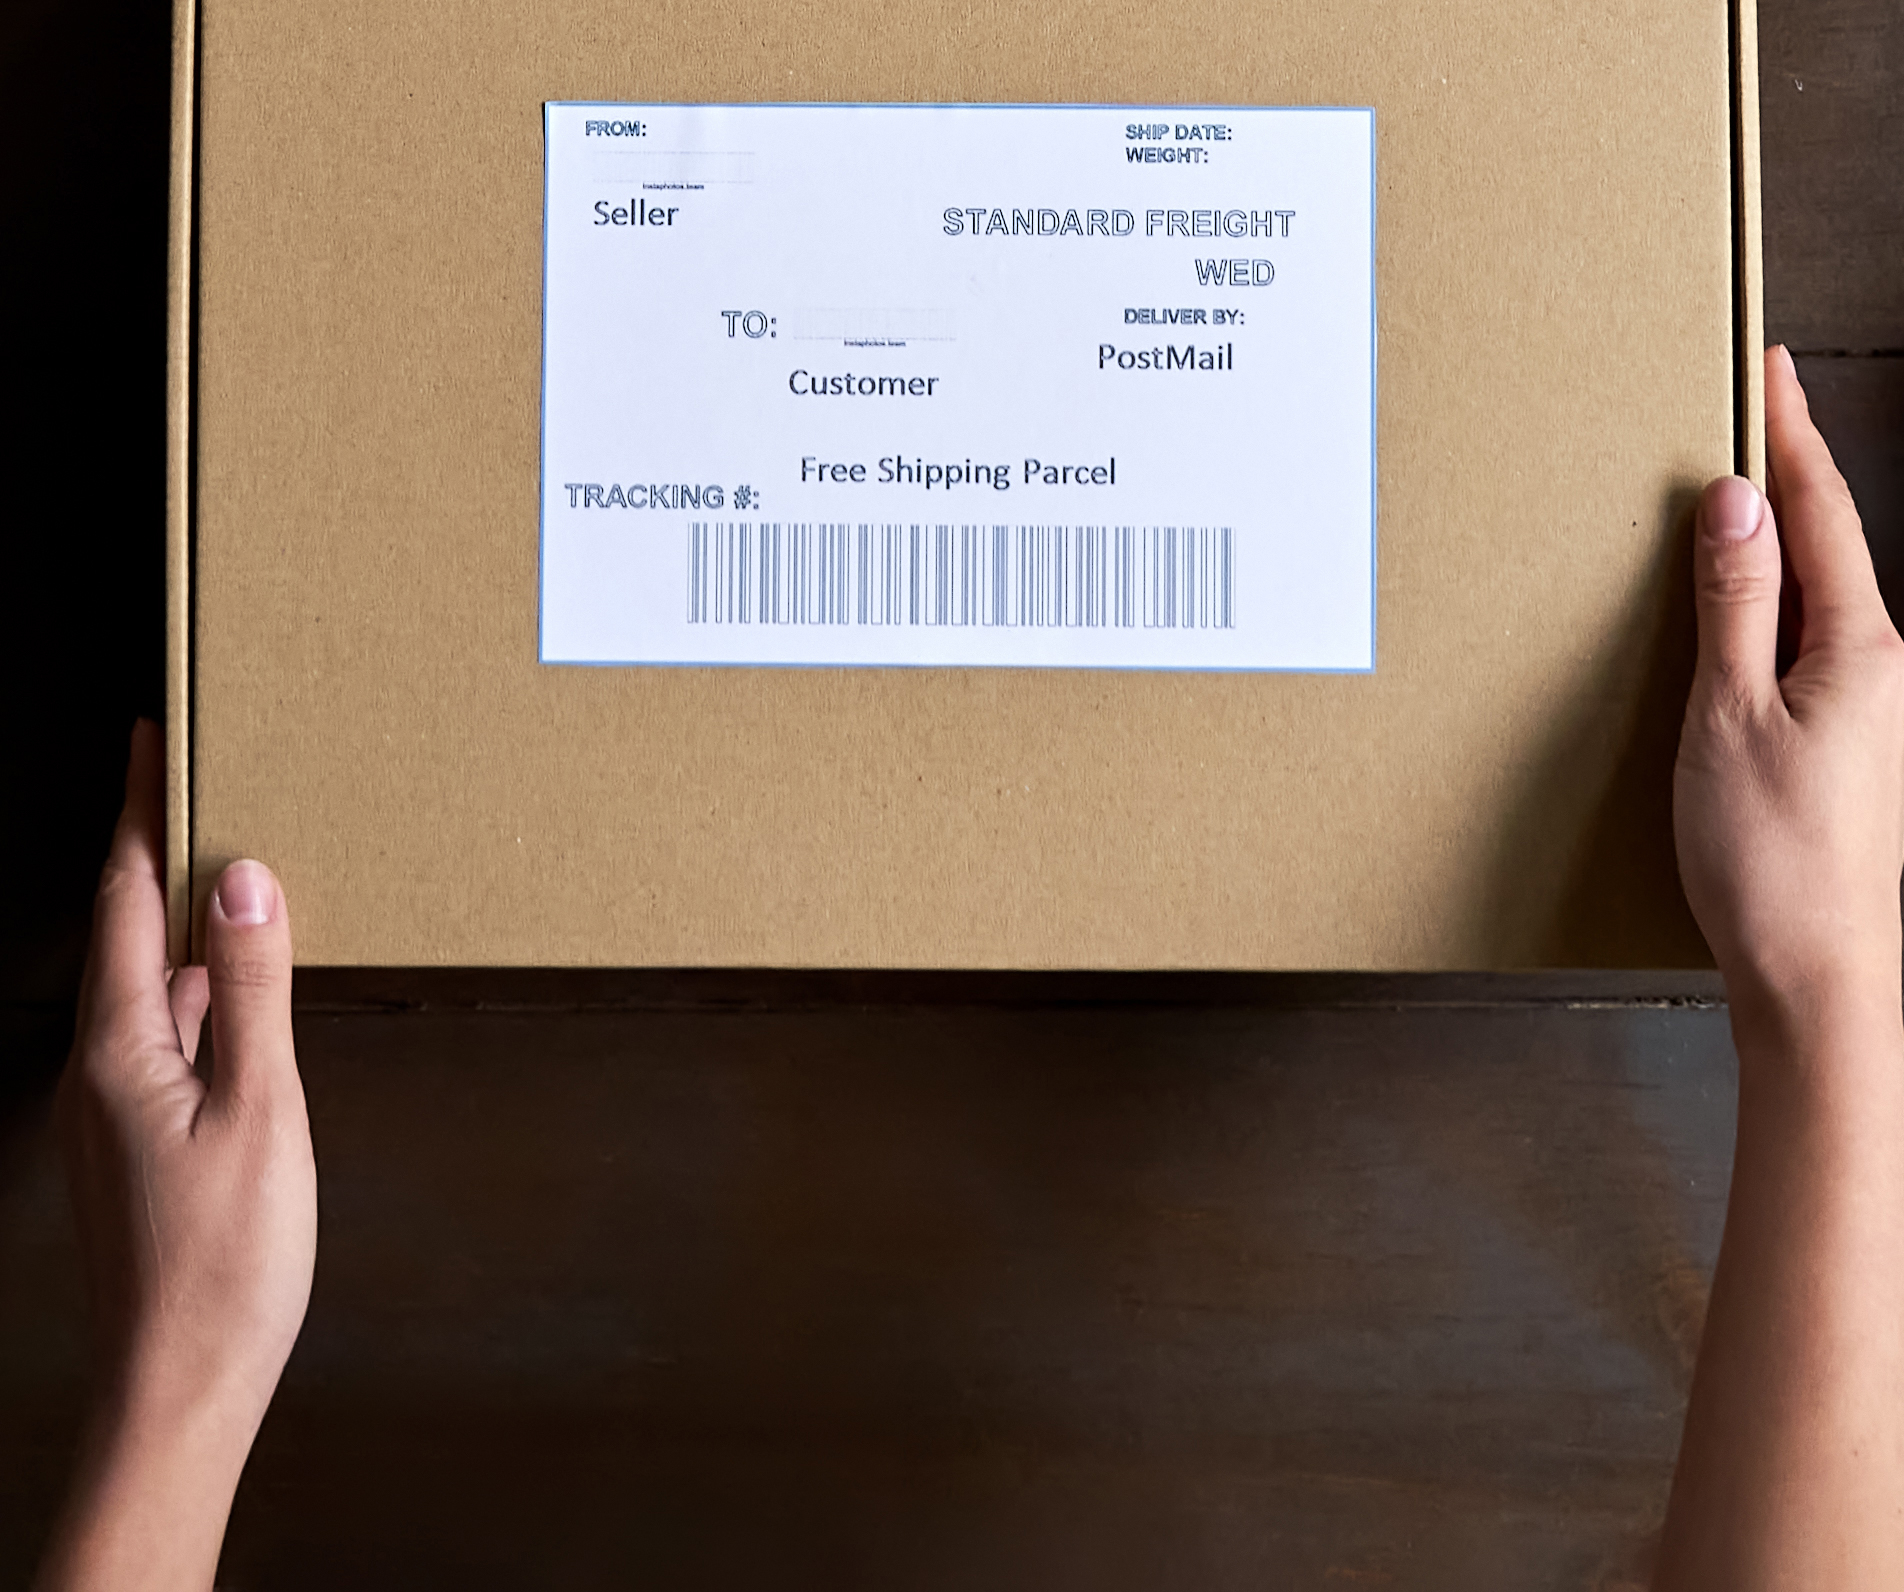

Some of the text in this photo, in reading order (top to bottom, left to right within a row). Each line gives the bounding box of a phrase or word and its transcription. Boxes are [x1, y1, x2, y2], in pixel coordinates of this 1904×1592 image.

[586, 120, 647, 138] FROM:
[1125, 124, 1233, 142] SHIP DATE:
[1126, 147, 1208, 164] WEIGHT:
[593, 198, 679, 226] Seller
[943, 207, 1296, 239] STANDARD FREIGHT
[1194, 258, 1275, 288] WED
[721, 310, 777, 339] TO:
[1124, 308, 1246, 326] DELIVER BY:
[1099, 342, 1233, 371] PostMail
[789, 369, 939, 398] Customer
[801, 454, 1115, 492] Free Shipping Parcel
[564, 483, 760, 512] TRACKING #:
